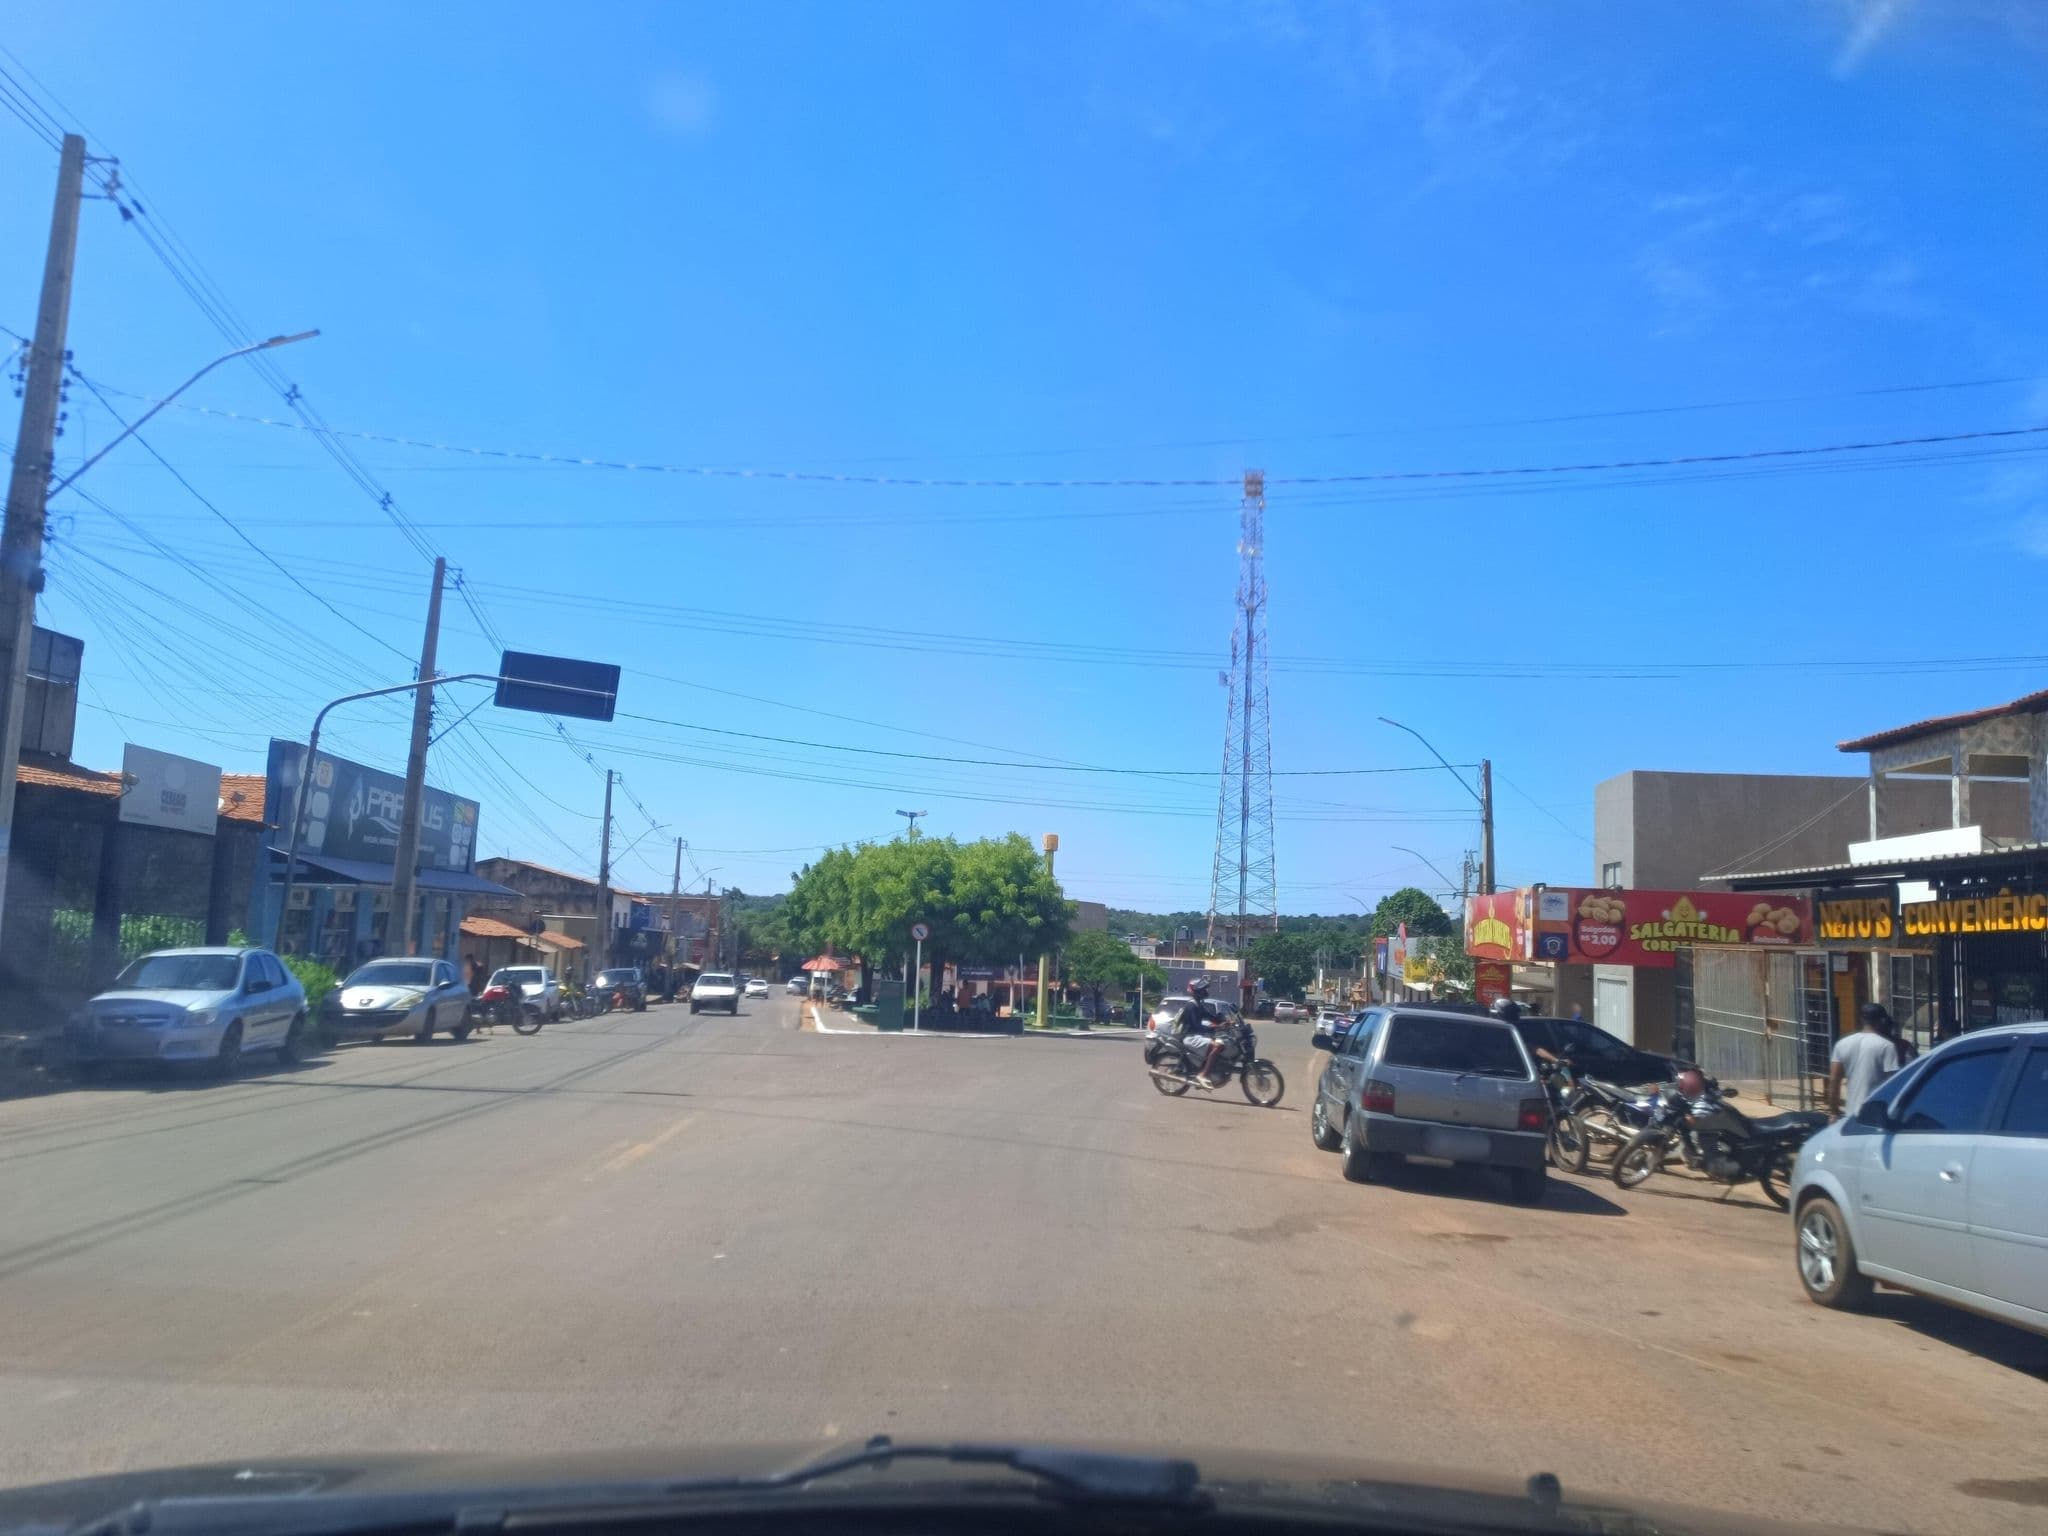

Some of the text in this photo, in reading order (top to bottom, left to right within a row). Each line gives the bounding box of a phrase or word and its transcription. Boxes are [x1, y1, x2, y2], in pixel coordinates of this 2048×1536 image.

[1905, 888, 2048, 935] CONVENIÊNC
[1579, 925, 1616, 935] Salgados
[1630, 921, 1740, 942] SALGATERIA
[1591, 934, 1617, 945] 2,00
